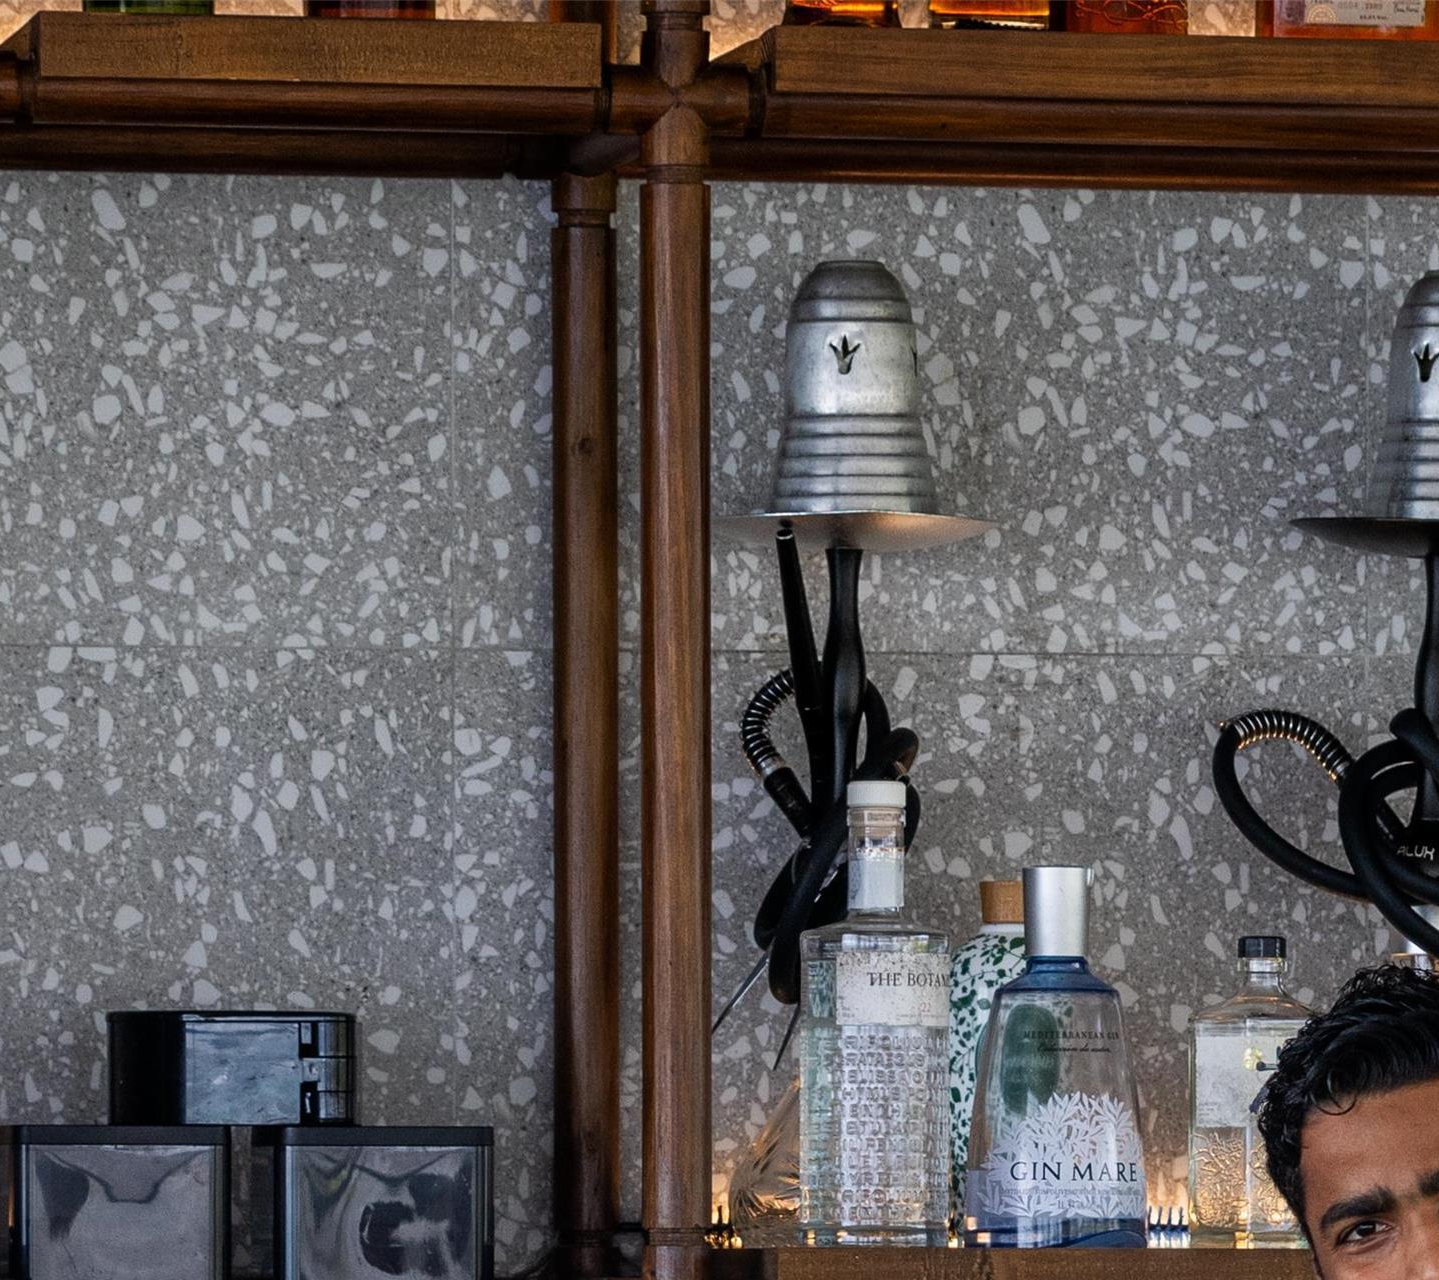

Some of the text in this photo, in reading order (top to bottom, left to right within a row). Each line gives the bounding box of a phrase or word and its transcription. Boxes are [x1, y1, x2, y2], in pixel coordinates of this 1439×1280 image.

[867, 971, 903, 987] THE
[1011, 1161, 1138, 1183] GIN MARE
